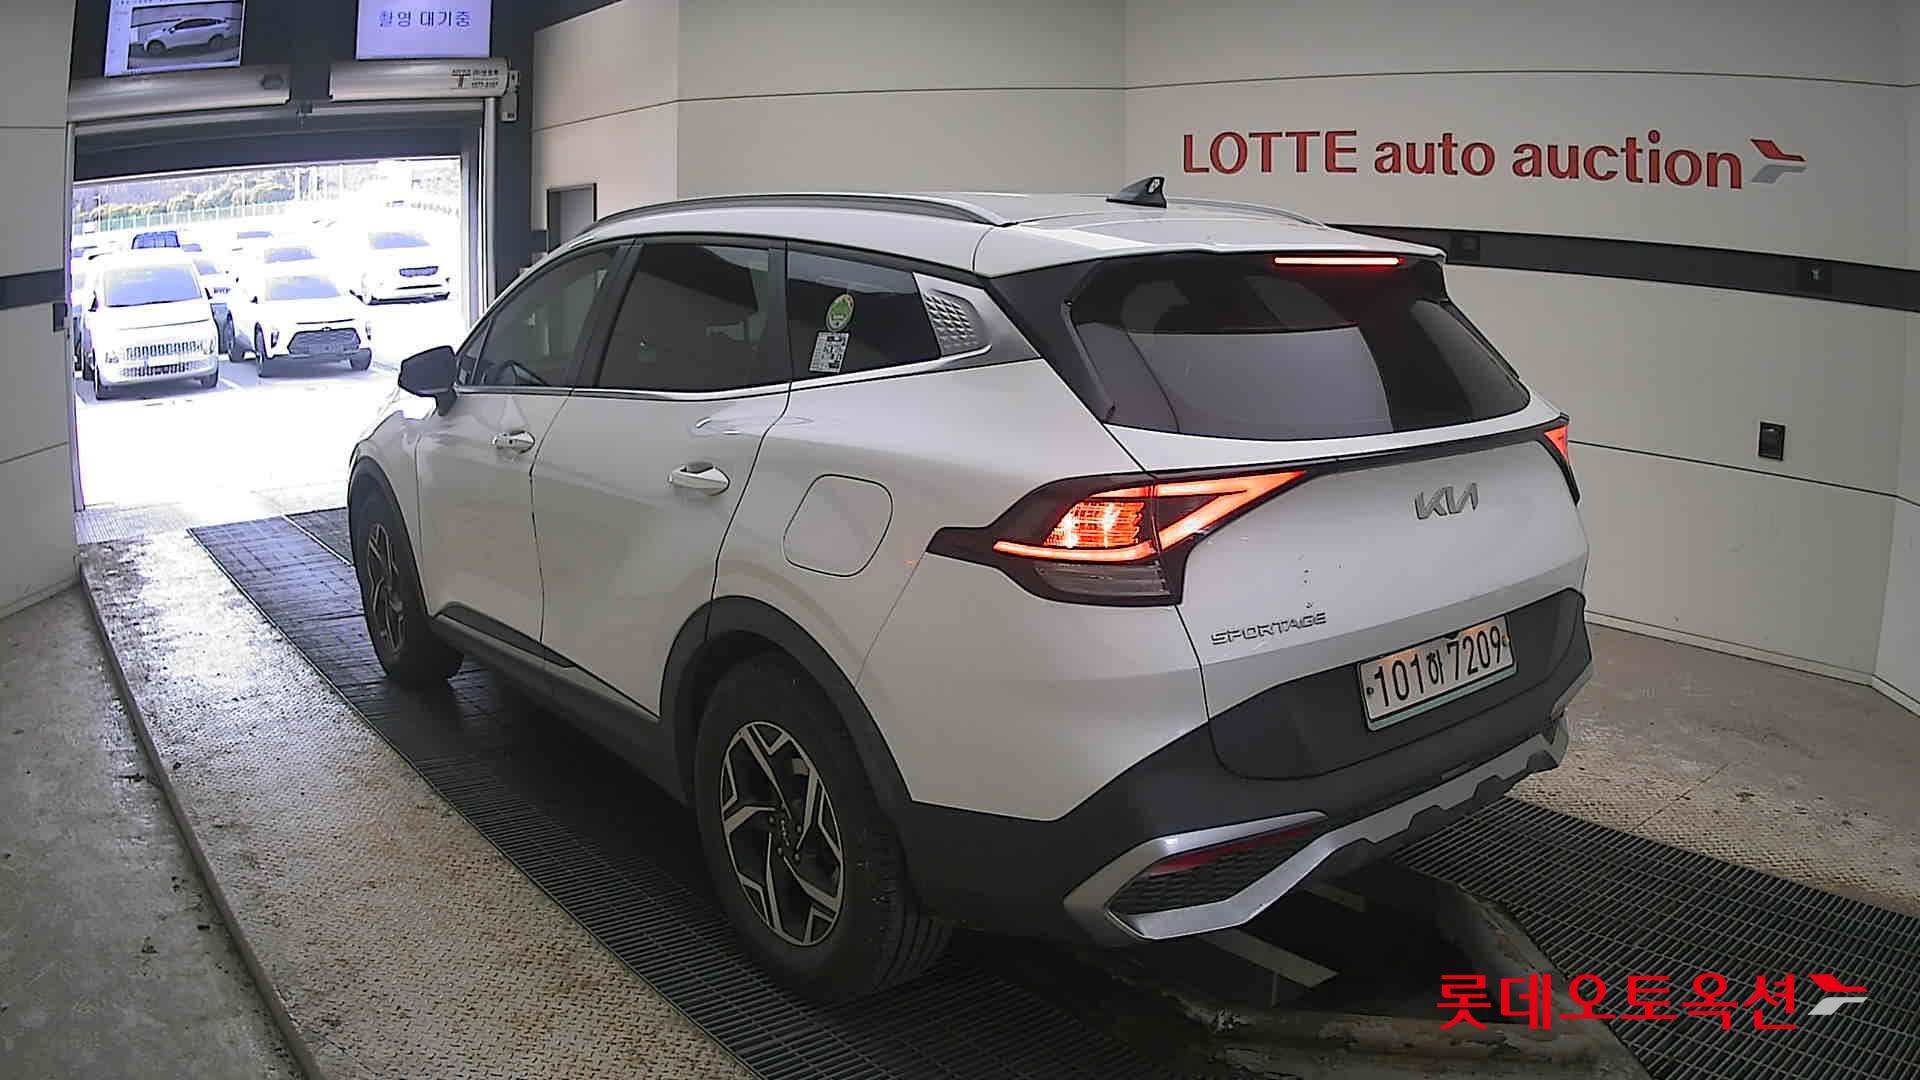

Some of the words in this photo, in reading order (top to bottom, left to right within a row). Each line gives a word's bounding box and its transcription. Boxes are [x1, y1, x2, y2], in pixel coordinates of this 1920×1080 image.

[420, 10, 471, 28] 대기중
[1184, 131, 1357, 174] LOTTE
[1374, 133, 1496, 176] auto
[1512, 130, 1743, 189] auction
[1415, 482, 1479, 519] KIA
[1211, 612, 1327, 645] SPORTAGE
